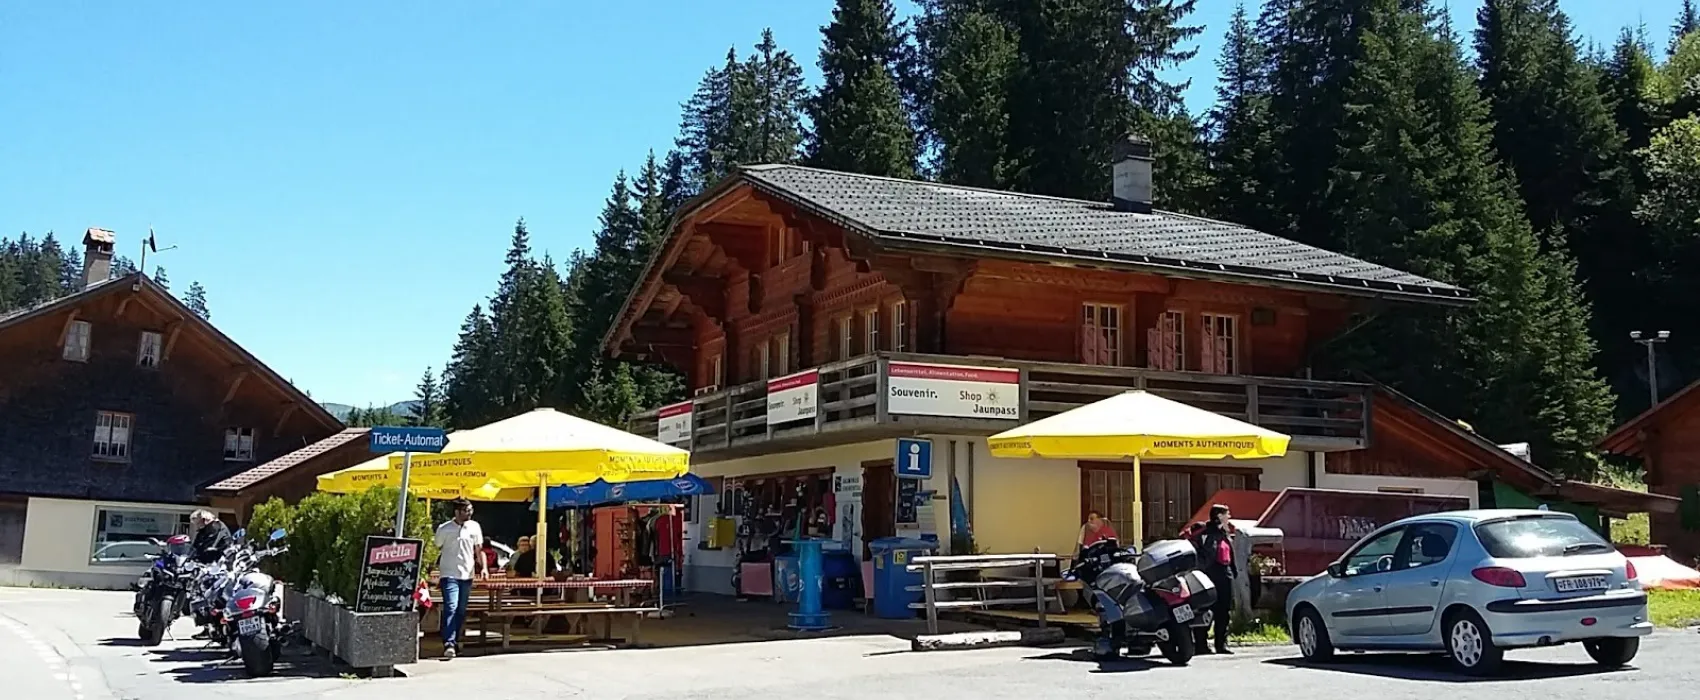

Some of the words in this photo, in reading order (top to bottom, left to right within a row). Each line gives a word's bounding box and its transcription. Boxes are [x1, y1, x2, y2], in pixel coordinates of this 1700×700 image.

[891, 387, 938, 399] Souvenir.
[959, 390, 982, 402] Shop
[973, 404, 1017, 416] Jaunpass
[373, 432, 444, 447] Ticket-Automat
[1153, 440, 1194, 448] MOMENTS
[1195, 440, 1255, 449] AUTHENTIQUES
[423, 457, 472, 468] AUTHENTIQUES
[375, 545, 411, 560] rivella
